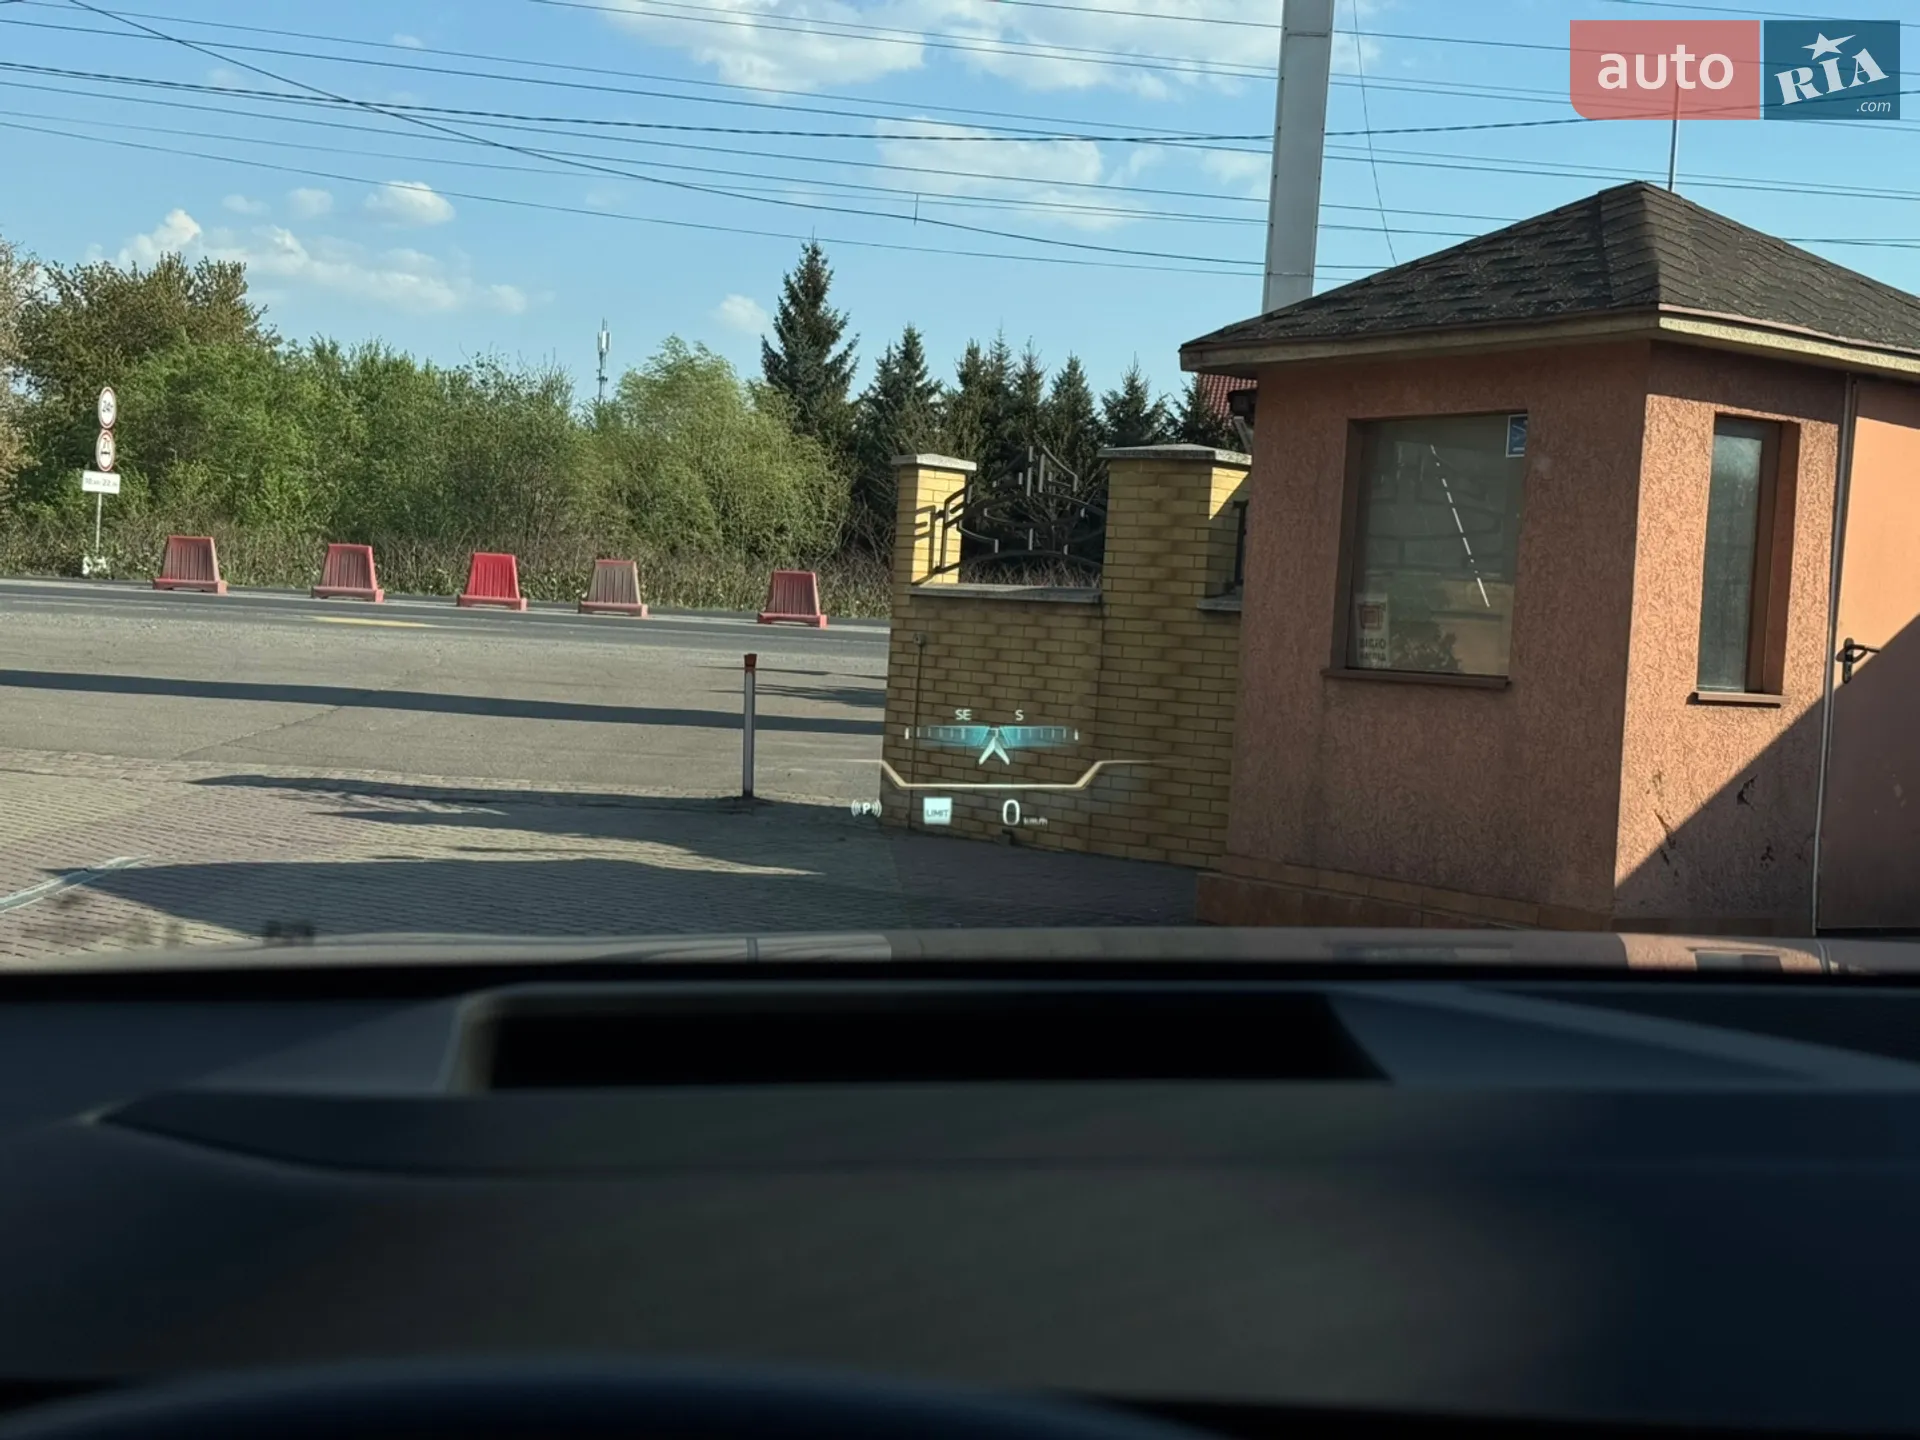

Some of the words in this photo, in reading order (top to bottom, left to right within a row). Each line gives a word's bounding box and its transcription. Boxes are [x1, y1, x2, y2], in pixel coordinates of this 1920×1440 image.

[955, 709, 972, 720] SE
[1015, 709, 1024, 721] S
[926, 809, 949, 817] LIMIT
[1003, 799, 1020, 826] 0
